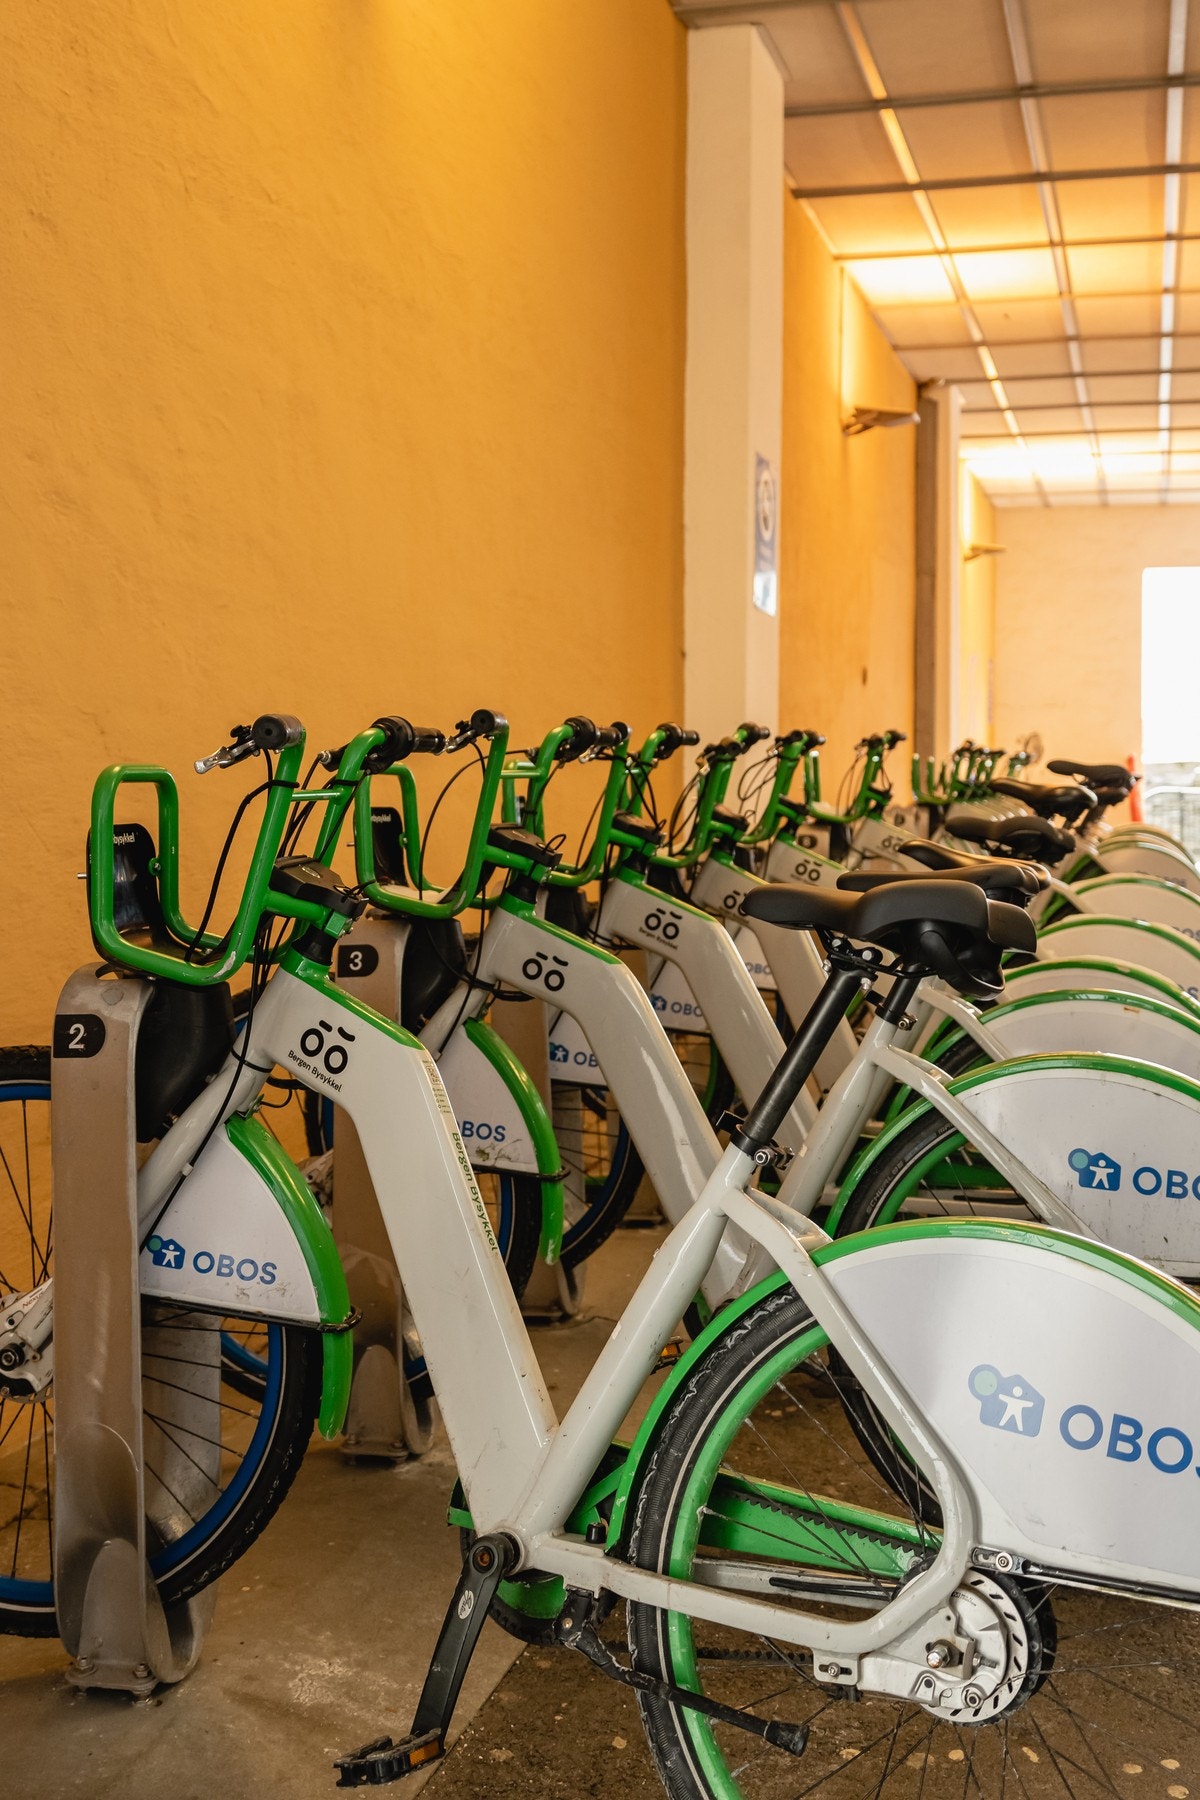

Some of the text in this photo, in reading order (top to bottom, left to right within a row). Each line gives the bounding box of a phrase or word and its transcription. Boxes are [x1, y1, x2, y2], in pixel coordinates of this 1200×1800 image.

[349, 951, 363, 971] 3
[745, 962, 773, 975] OBO
[671, 1002, 703, 1018] OBO
[68, 1023, 85, 1049] 2
[288, 1050, 342, 1092] Bergen Bysykkel
[574, 1051, 600, 1068] OB
[461, 1120, 506, 1143] BOS
[452, 1132, 498, 1251] Bergen Bysykkel
[192, 1251, 278, 1285] OBOS
[1059, 1404, 1200, 1479] OBO
